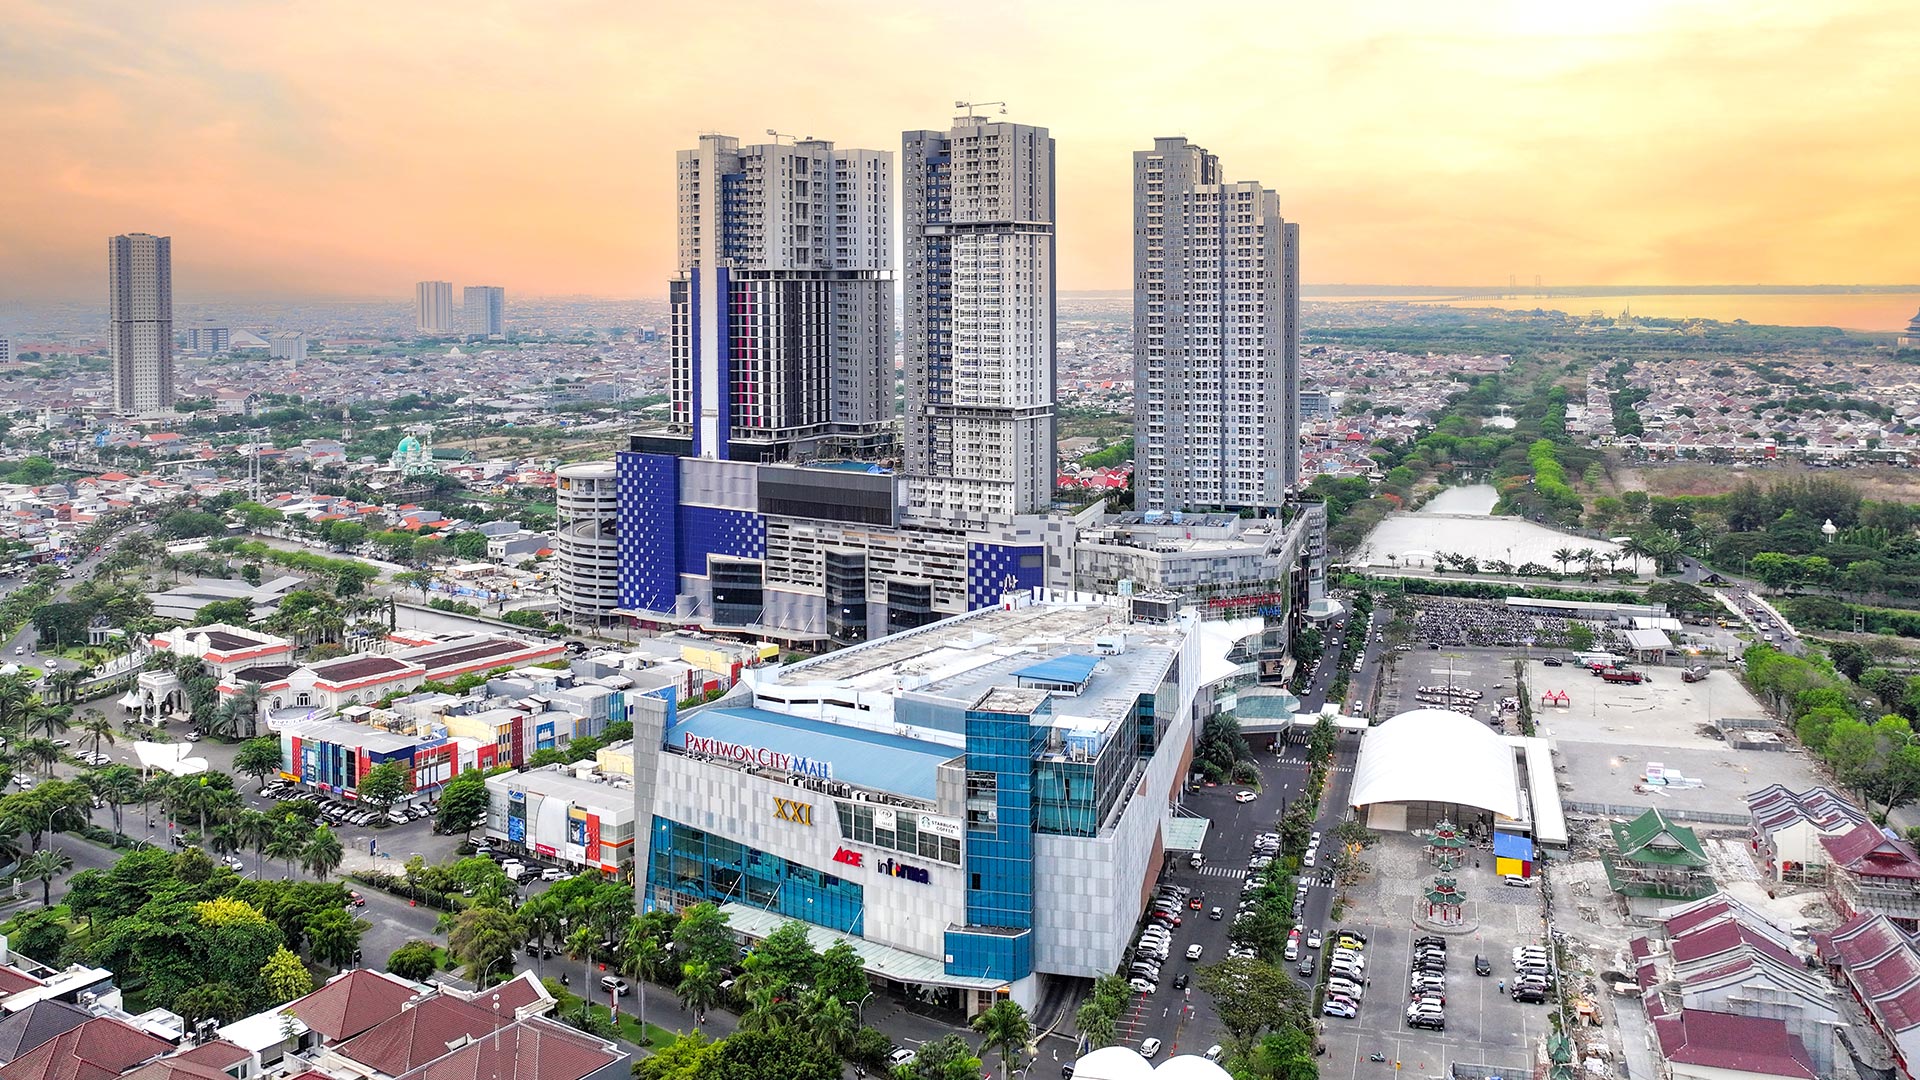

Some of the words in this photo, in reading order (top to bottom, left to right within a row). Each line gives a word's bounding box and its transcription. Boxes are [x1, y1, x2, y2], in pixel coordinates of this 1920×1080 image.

[685, 732, 755, 762] PAKUWON
[758, 748, 790, 769] CITY
[793, 756, 830, 779] MALL
[773, 797, 812, 826] XXI
[931, 820, 959, 830] STARBUCKS
[832, 846, 863, 866] ACE
[877, 857, 930, 884] informa
